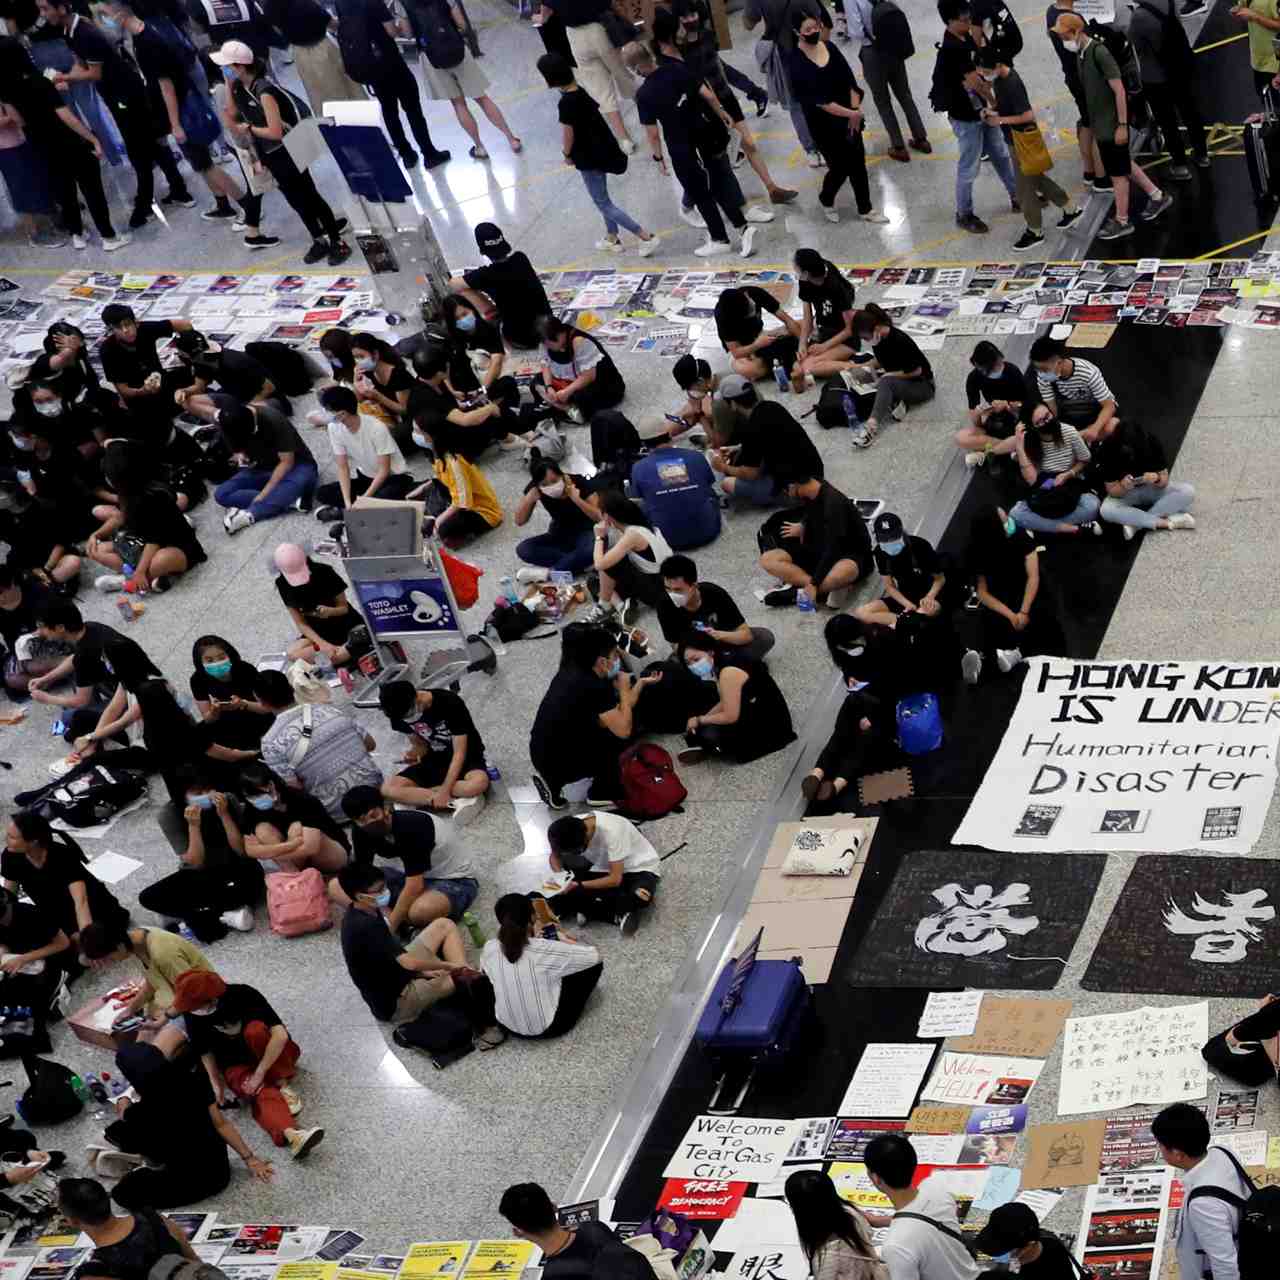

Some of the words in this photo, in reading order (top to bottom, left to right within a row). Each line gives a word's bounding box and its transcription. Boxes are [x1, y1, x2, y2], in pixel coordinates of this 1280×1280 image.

[368, 600, 391, 609] TOTO
[1036, 662, 1185, 693] HONG
[1050, 694, 1118, 724] IS
[1028, 762, 1265, 795] Disaster
[698, 1118, 787, 1136] Welcome
[717, 1136, 744, 1148] To
[685, 1143, 729, 1161] Tear
[733, 1147, 775, 1164] Gas
[693, 1163, 739, 1180] City
[681, 1181, 729, 1193] FREE
